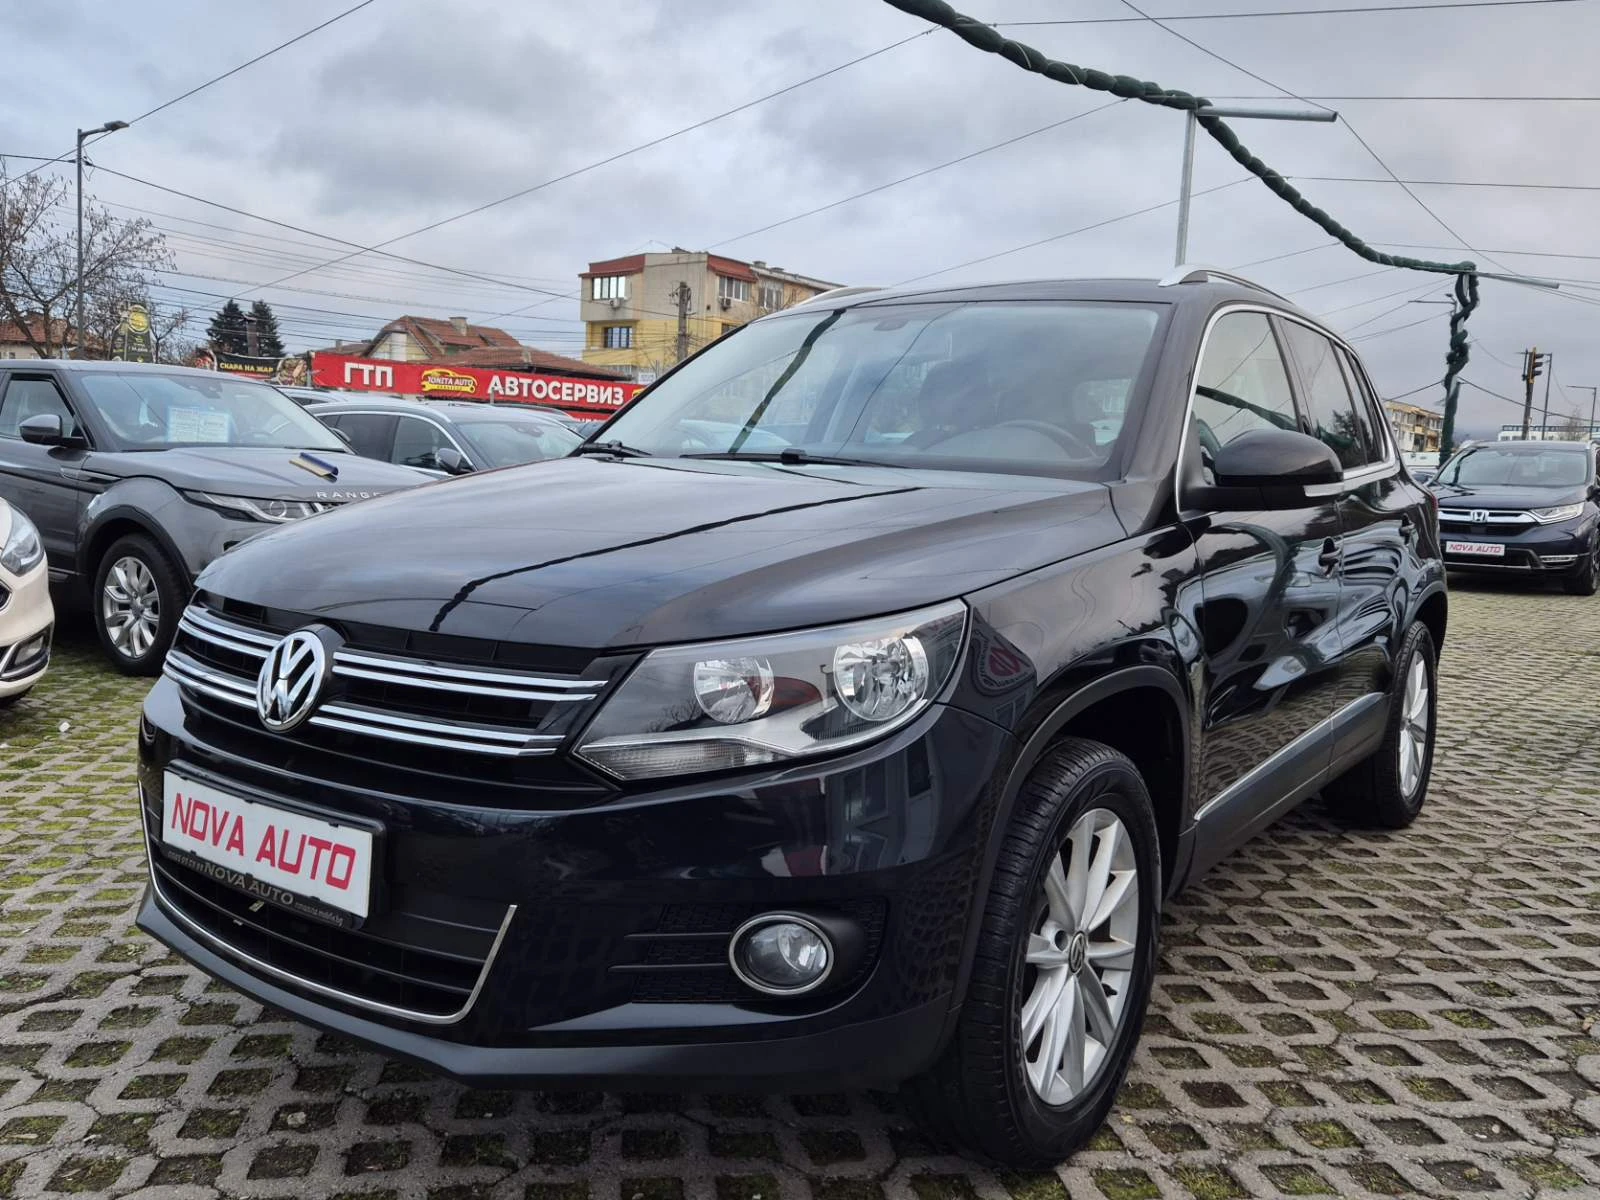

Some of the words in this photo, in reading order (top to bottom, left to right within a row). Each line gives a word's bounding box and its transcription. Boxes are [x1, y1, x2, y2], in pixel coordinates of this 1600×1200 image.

[244, 364, 255, 372] НА
[343, 361, 394, 388] ГТП
[453, 378, 474, 387] AUTO
[487, 374, 625, 405] АВТОСЕРВИЗ
[1449, 543, 1473, 552] NOVA
[1476, 545, 1501, 553] AUTO
[171, 792, 245, 857] NOVA
[255, 824, 356, 891] AUTO
[203, 862, 246, 887] NOVA
[248, 880, 294, 905] AUTO
